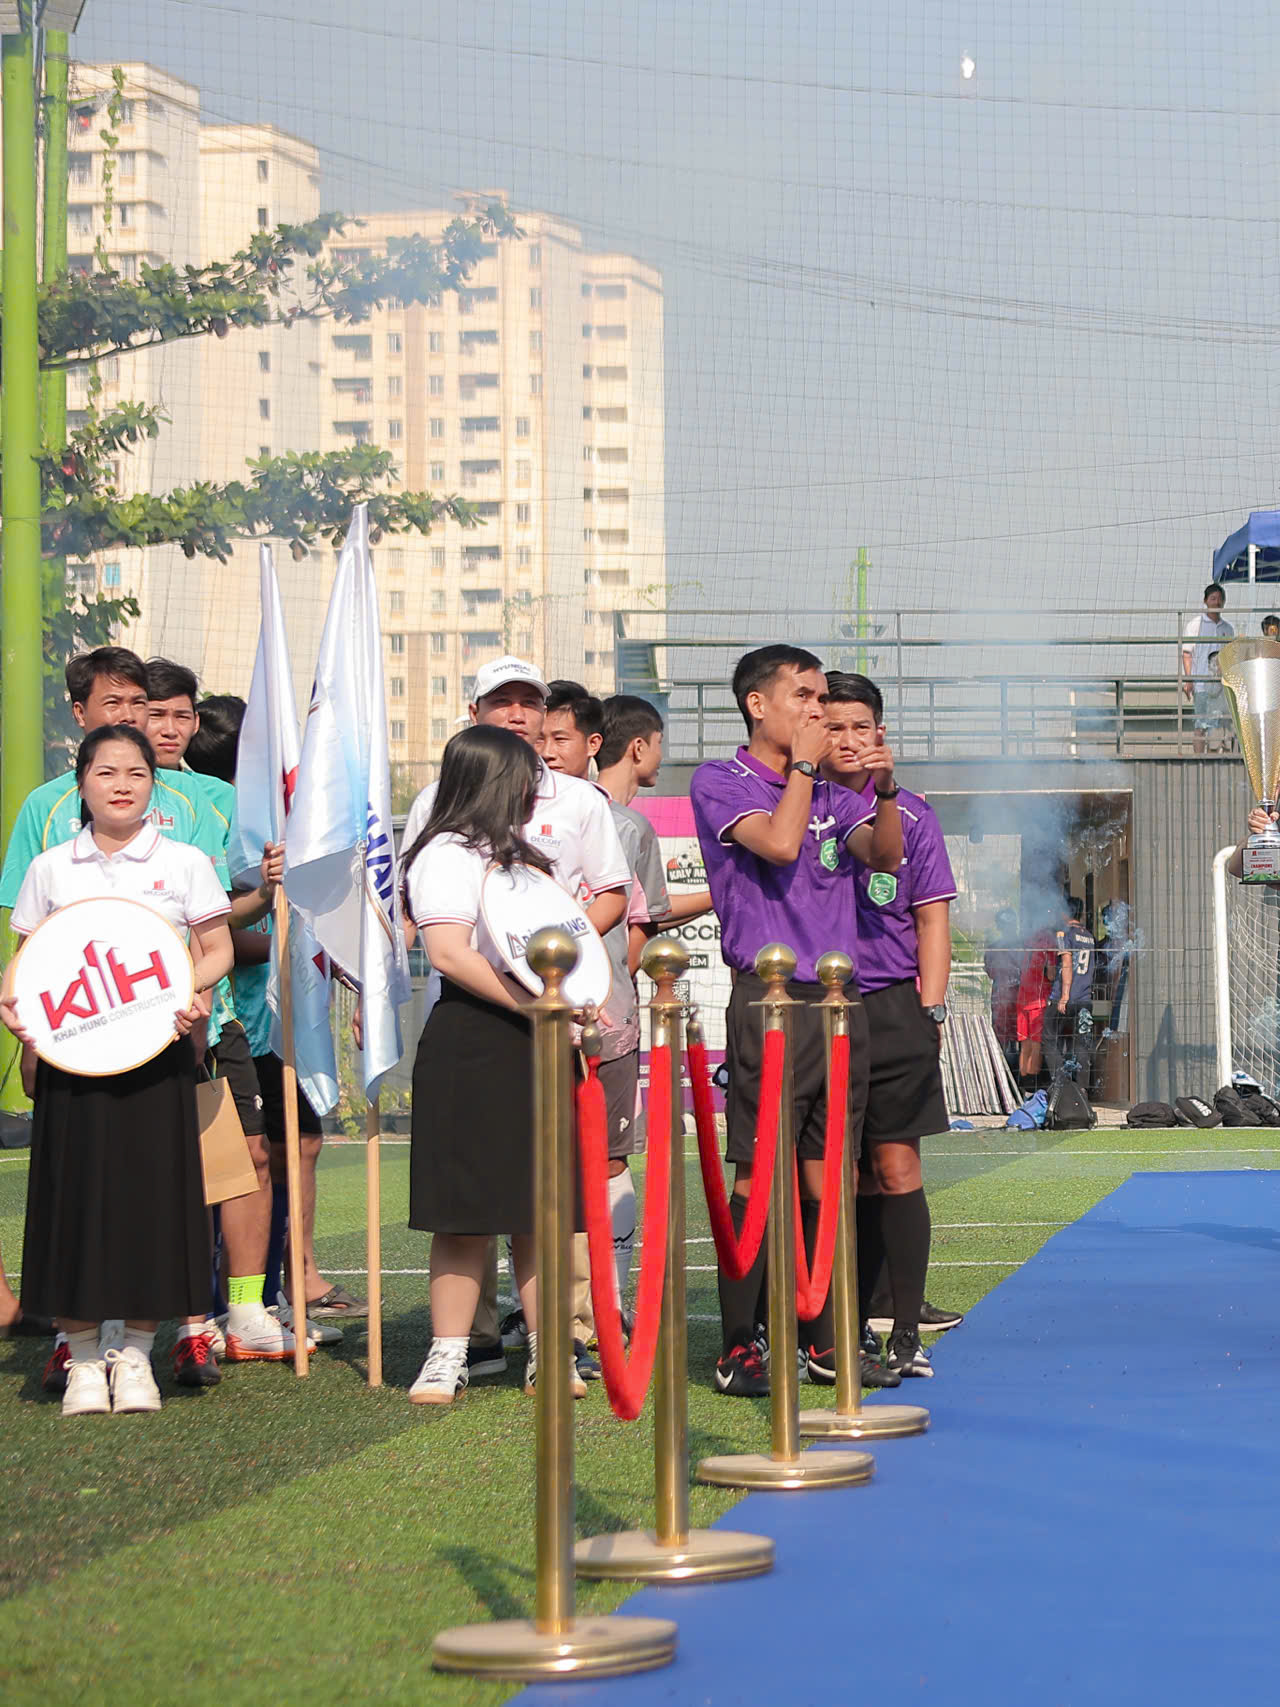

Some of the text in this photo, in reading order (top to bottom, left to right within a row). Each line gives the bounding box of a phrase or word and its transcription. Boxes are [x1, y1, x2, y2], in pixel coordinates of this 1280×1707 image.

[52, 990, 177, 1043] KHAI HUNG CONSTRUCTION
